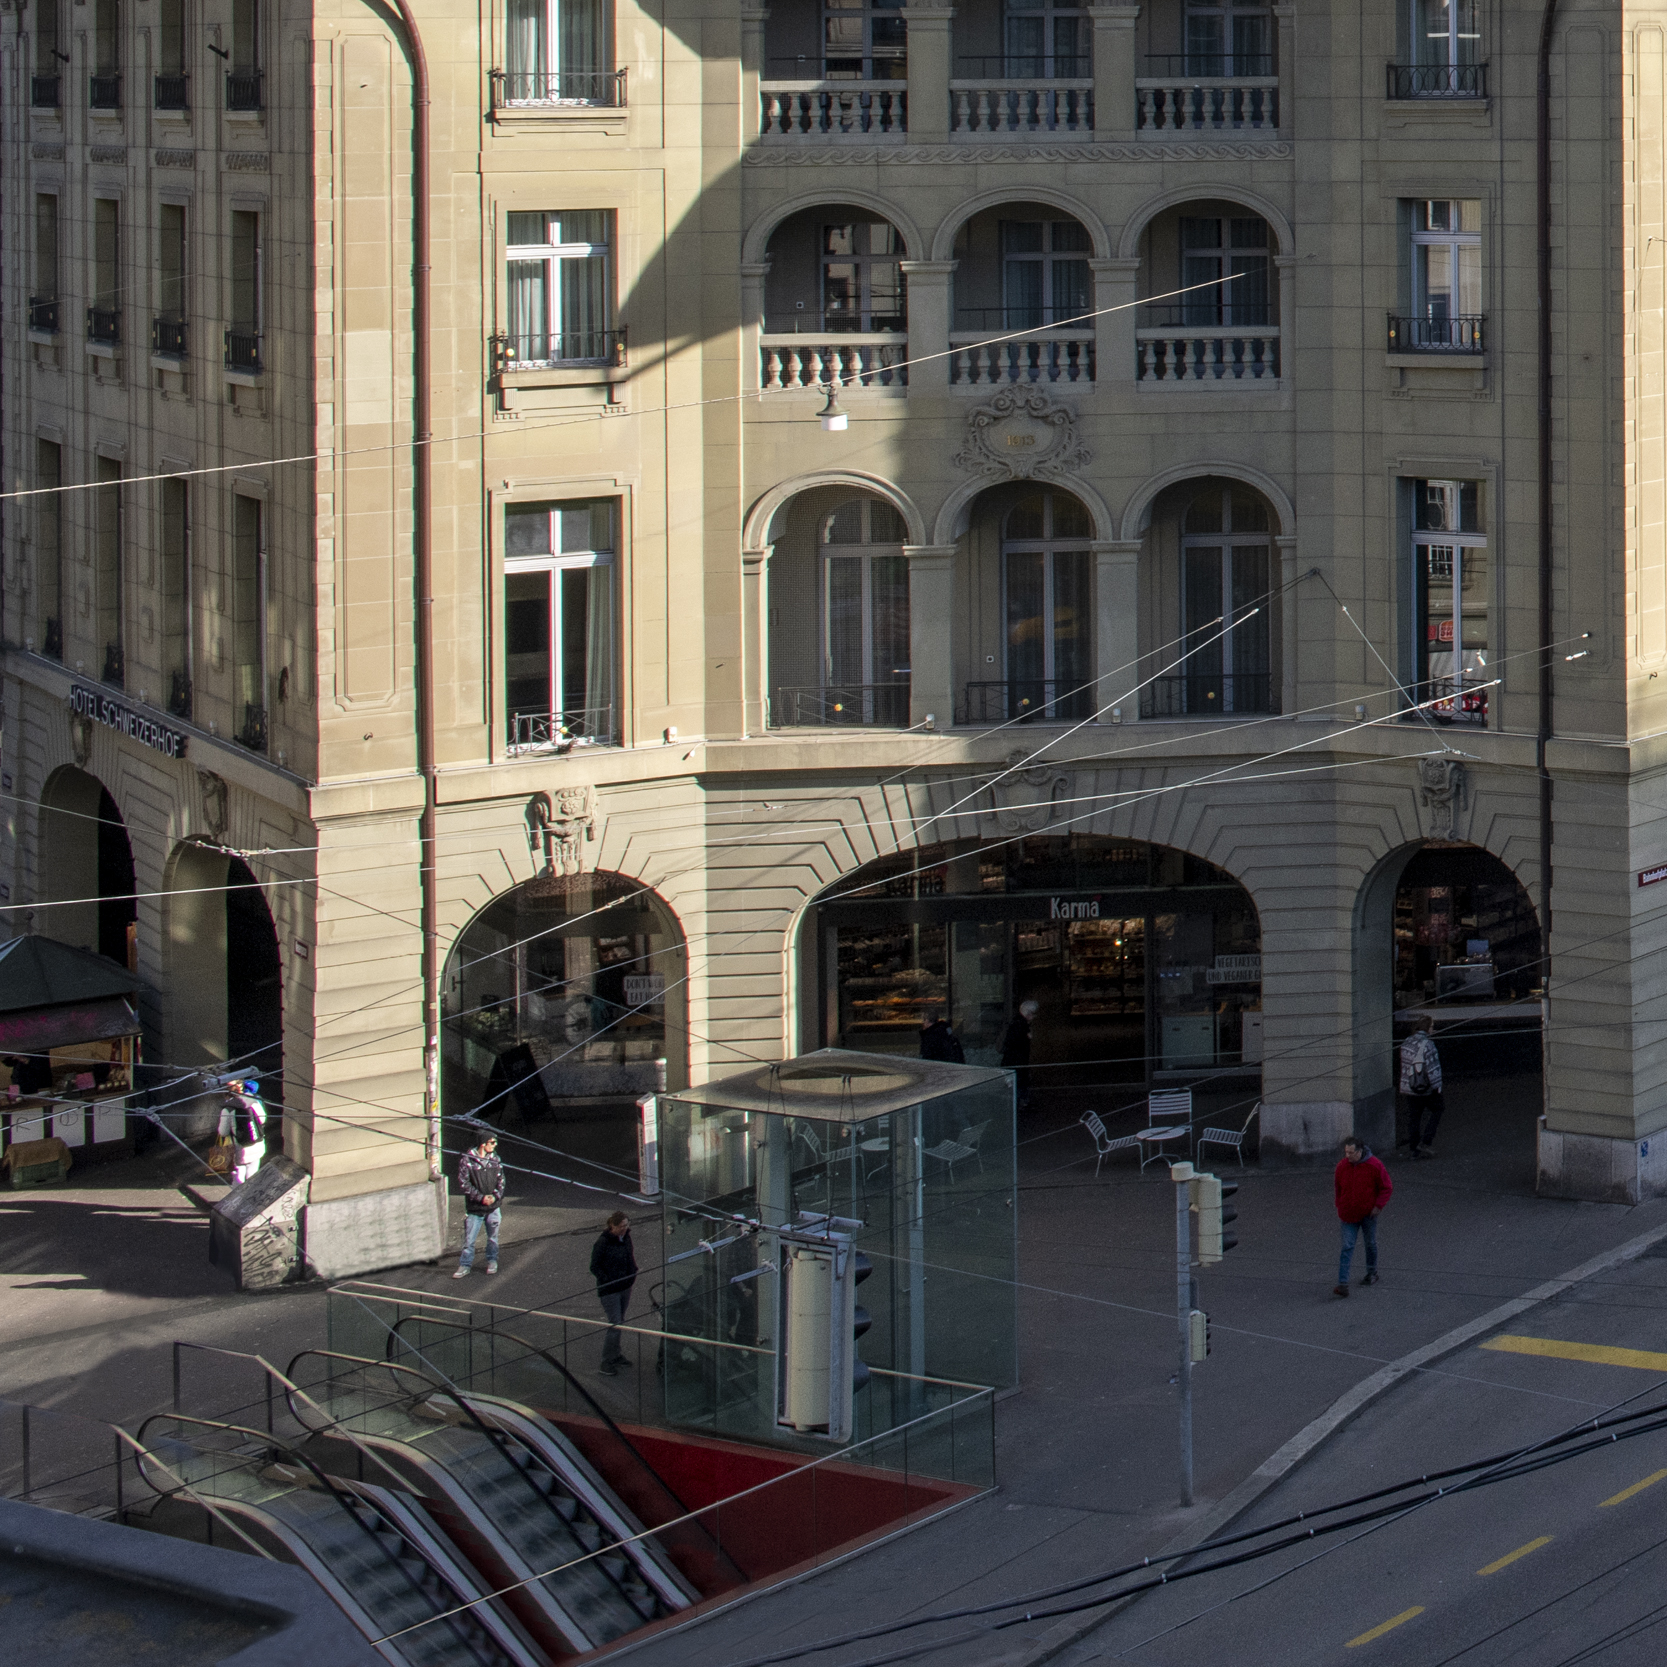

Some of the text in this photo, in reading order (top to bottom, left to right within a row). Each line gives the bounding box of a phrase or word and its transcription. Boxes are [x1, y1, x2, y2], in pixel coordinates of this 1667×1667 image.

[70, 683, 181, 760] HOTEL SCHWEIZERHOF
[1051, 897, 1099, 918] Karma
